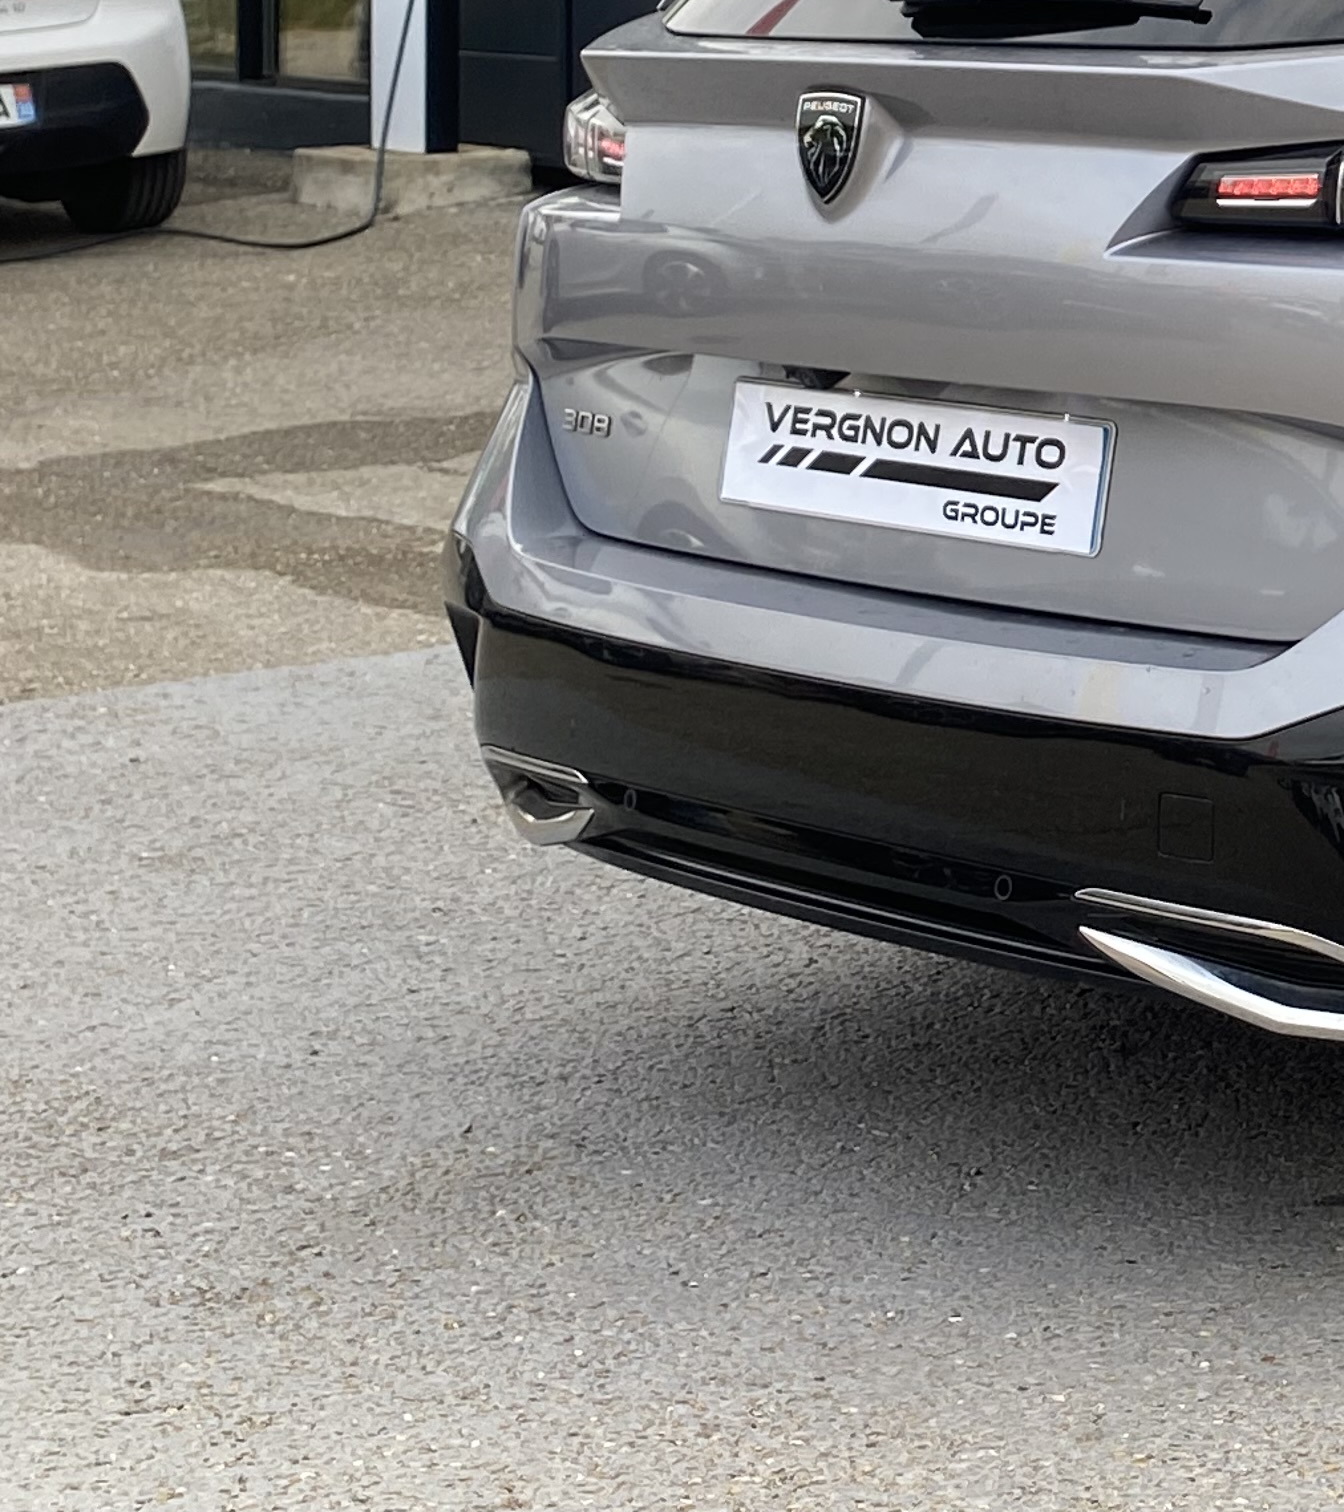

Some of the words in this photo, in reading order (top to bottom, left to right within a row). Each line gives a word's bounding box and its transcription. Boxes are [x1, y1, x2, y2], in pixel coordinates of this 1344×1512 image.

[802, 100, 856, 115] PEUGEOT
[563, 407, 613, 439] 308
[764, 401, 940, 456] VERGNON
[950, 427, 1066, 470] AUTO
[941, 500, 1057, 536] GROUPE
